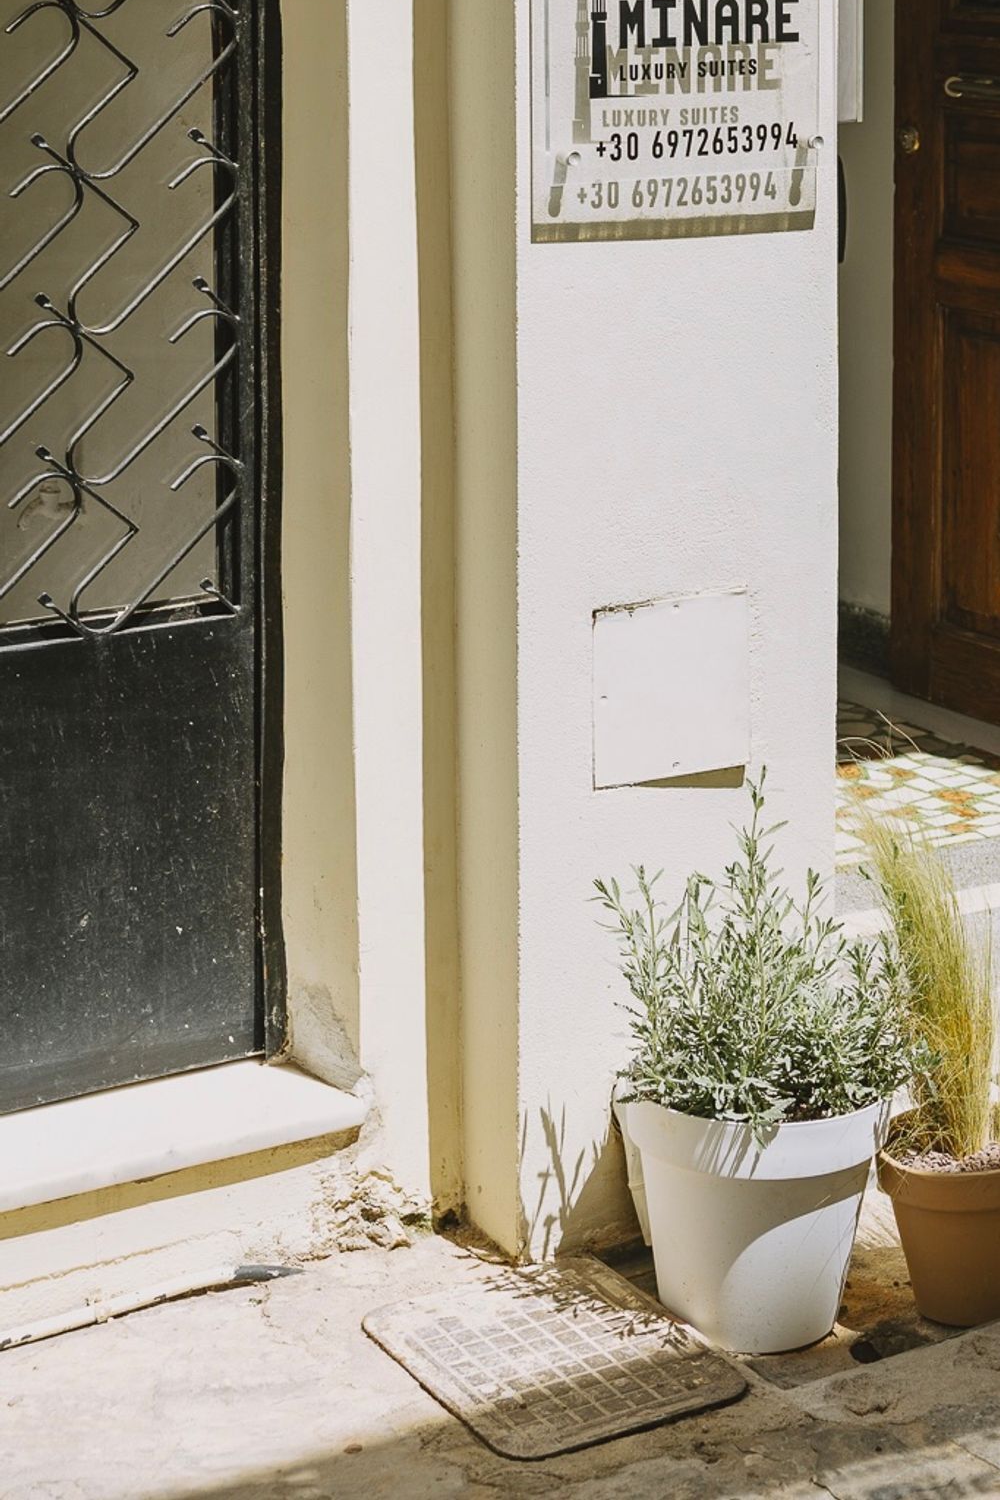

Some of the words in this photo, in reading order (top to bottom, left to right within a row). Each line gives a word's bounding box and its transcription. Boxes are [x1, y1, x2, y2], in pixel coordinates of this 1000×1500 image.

[619, 61, 688, 82] LUXURY
[697, 58, 757, 77] SUITES
[596, 132, 639, 161] +30
[652, 122, 798, 159] 6972653994
